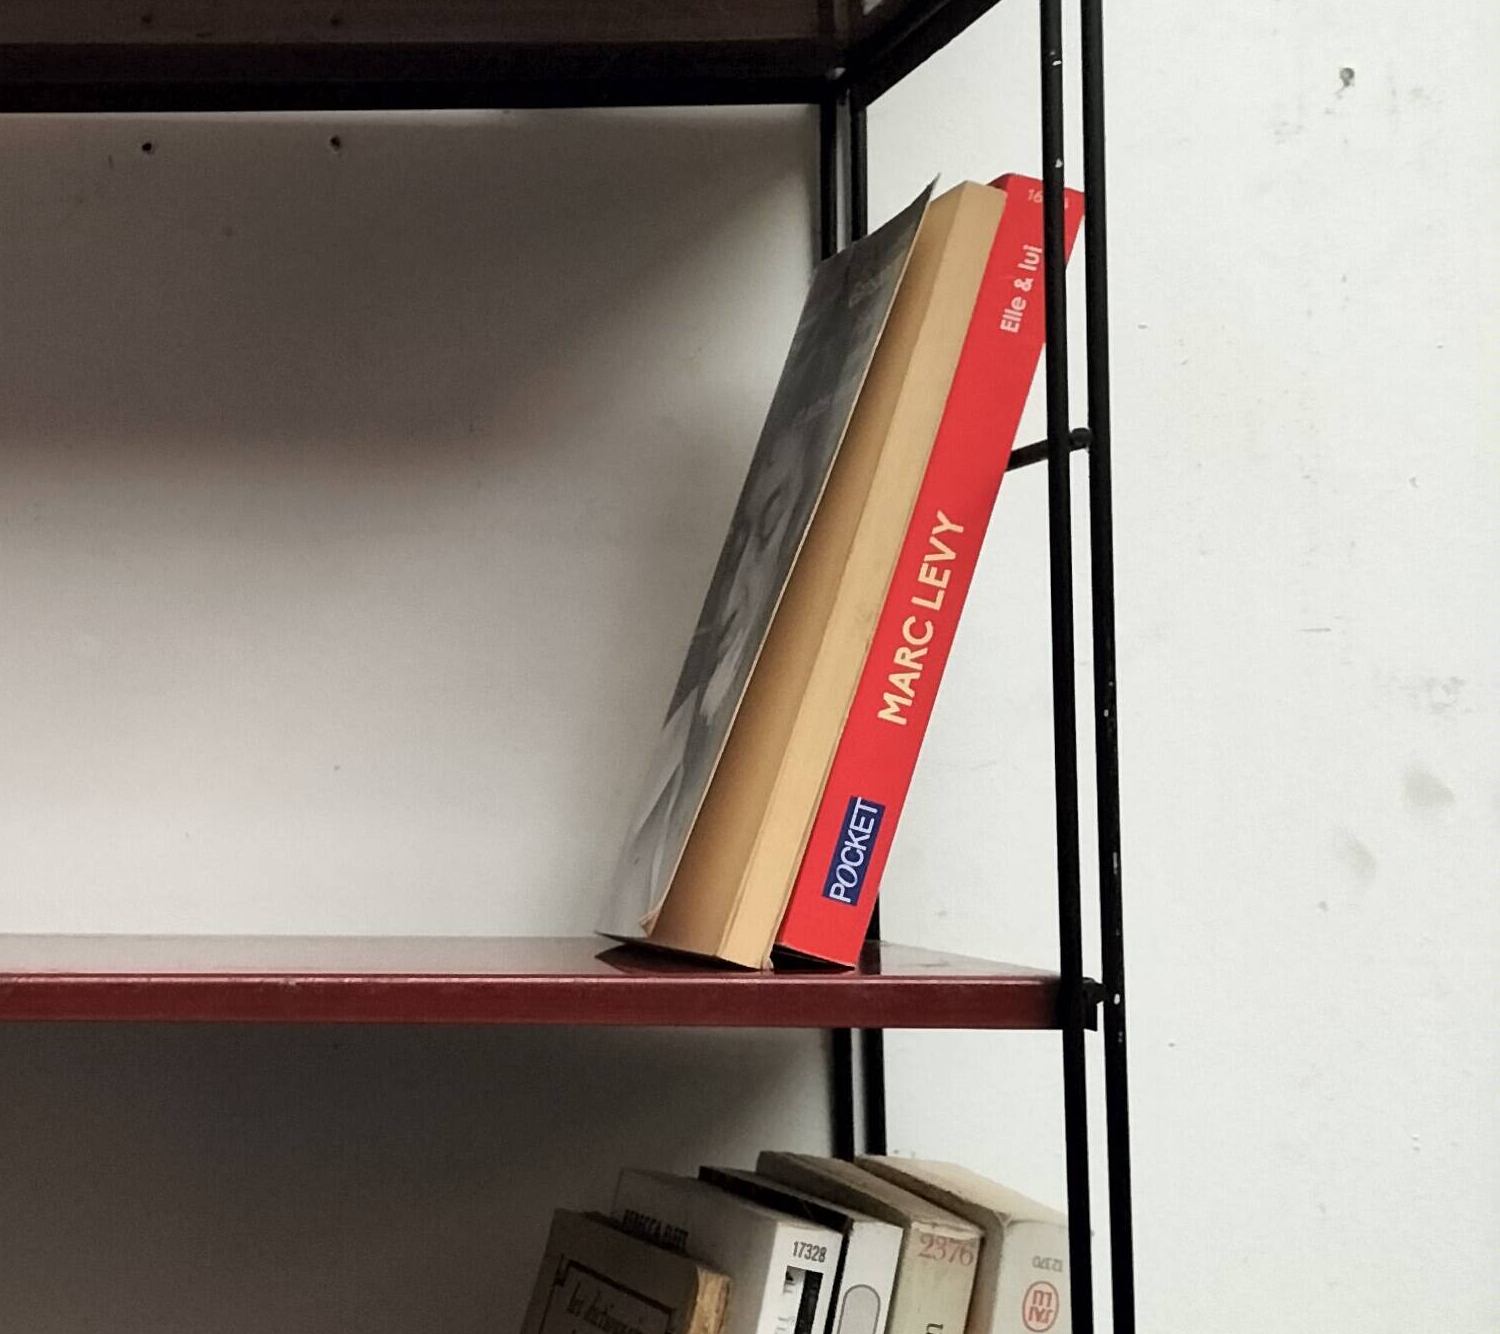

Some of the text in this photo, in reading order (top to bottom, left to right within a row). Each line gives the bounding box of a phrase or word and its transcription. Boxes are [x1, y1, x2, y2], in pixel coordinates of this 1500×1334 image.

[1000, 244, 1043, 333] Elle & lui
[877, 509, 966, 726] MARC LEVY
[828, 797, 884, 905] POCKET
[791, 1240, 829, 1263] 17328
[917, 1232, 976, 1268] 2376
[1031, 1288, 1054, 1308] LU
